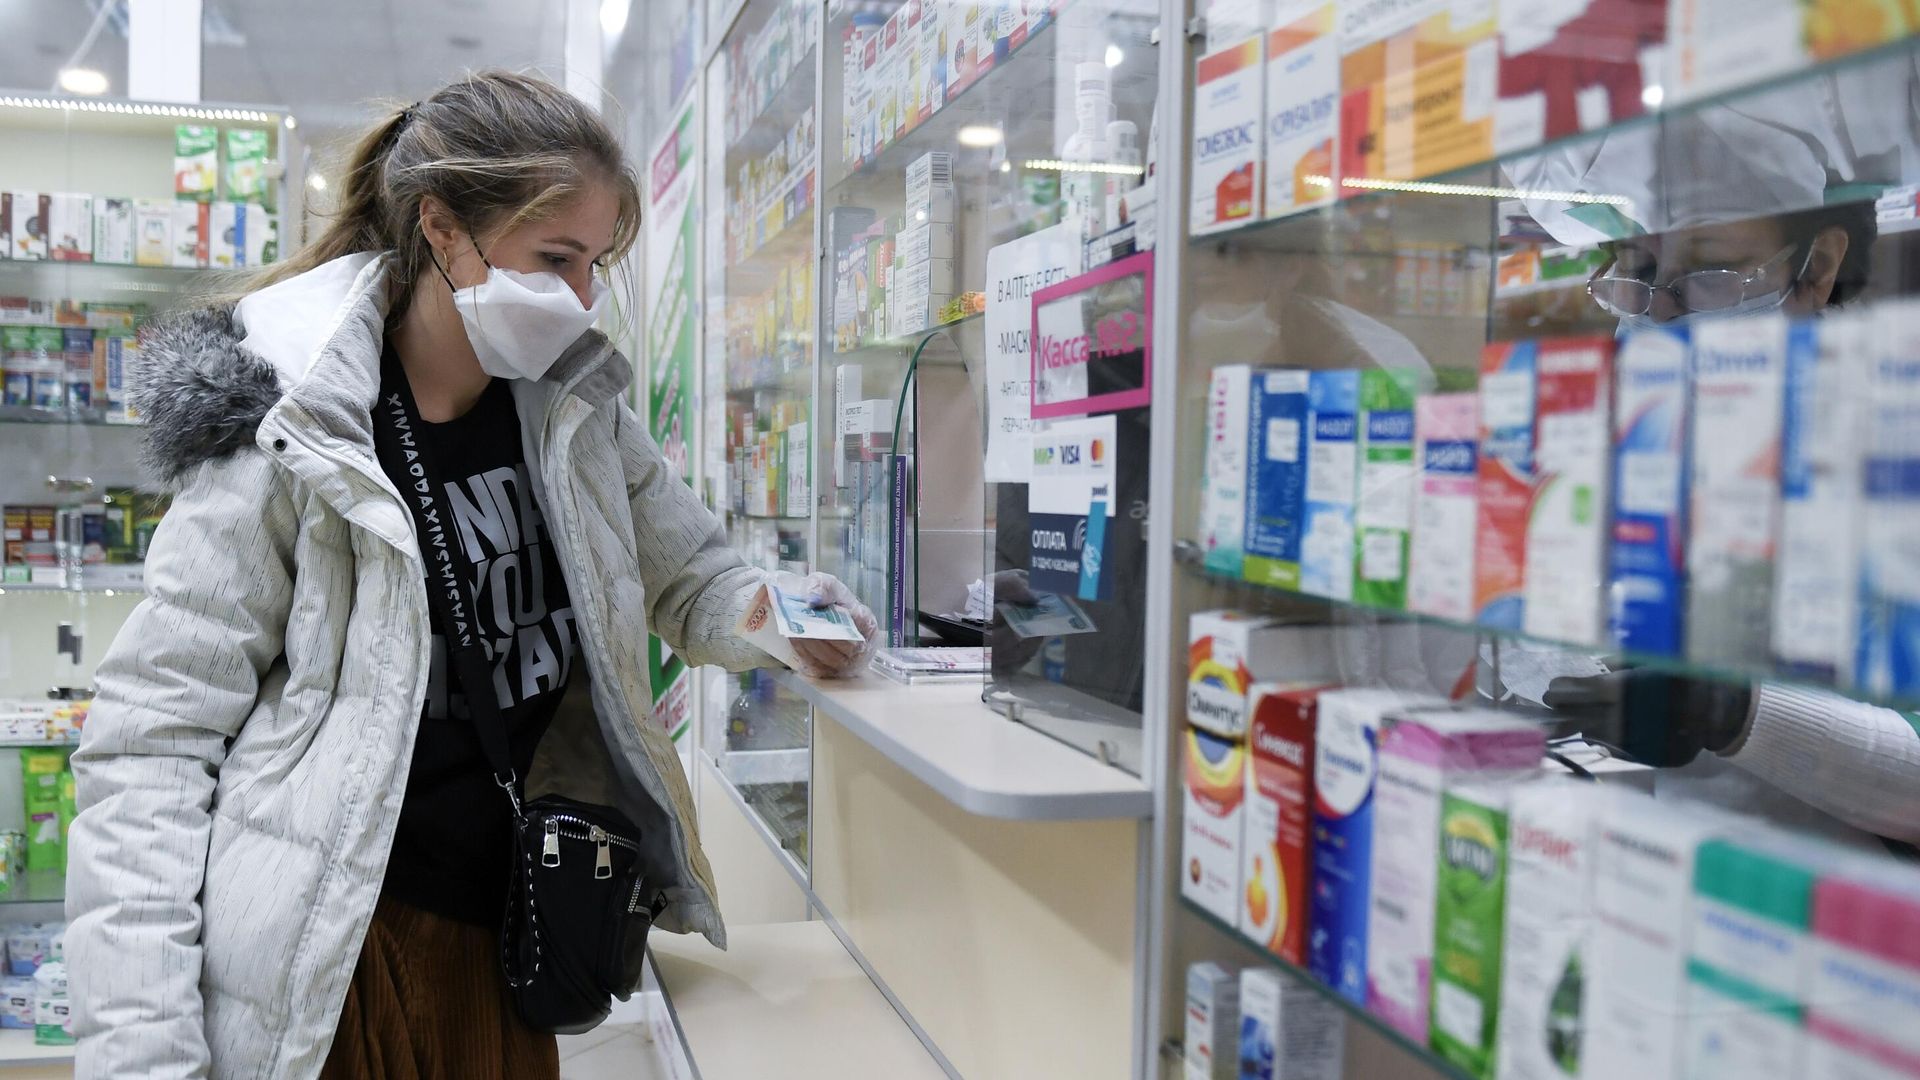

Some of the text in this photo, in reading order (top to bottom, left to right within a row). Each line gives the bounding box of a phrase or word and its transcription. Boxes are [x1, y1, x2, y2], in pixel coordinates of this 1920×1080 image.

[1041, 334, 1090, 370] Касса
[1060, 445, 1081, 465] VISA
[443, 463, 547, 564] NDA
[1032, 529, 1067, 551] ОПЛАТА
[745, 606, 767, 633] 5000
